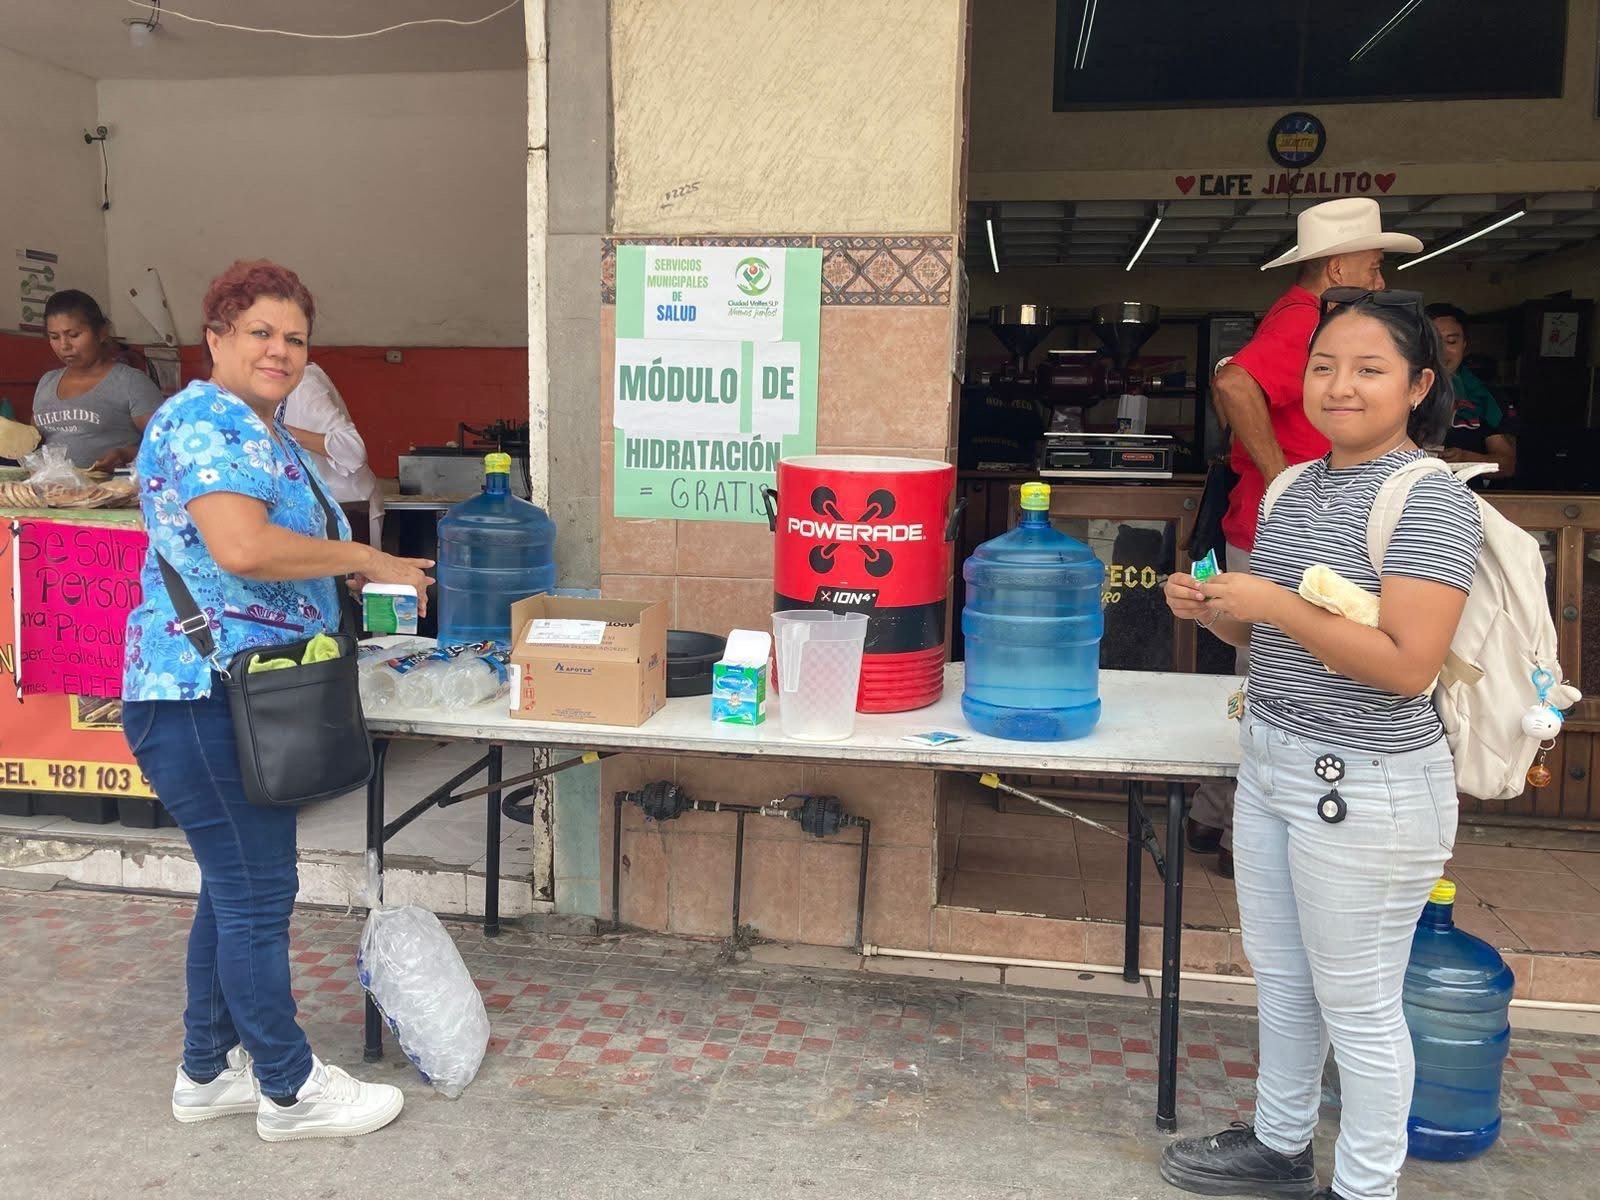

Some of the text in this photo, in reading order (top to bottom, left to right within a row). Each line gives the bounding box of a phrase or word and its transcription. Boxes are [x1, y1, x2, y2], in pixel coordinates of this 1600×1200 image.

[1200, 171, 1372, 196] CAFE JACALITO
[654, 258, 702, 272] SERVICIOS
[647, 275, 709, 289] MUNICIPALES
[672, 291, 683, 302] DE
[656, 304, 697, 322] SALUD
[619, 356, 794, 405] MÓDULO DE
[626, 434, 781, 472] HIDRATACIÓN
[670, 477, 770, 516] GRATIS
[19, 522, 69, 563] Se
[788, 517, 925, 542] POWERADE
[35, 566, 144, 609] Person
[1100, 591, 1121, 604] RO
[54, 612, 127, 646] Produ
[0, 643, 15, 674] N
[51, 644, 121, 669] Solicitud
[63, 673, 122, 700] ELEG
[48, 764, 87, 789] 481
[96, 767, 132, 791] 103
